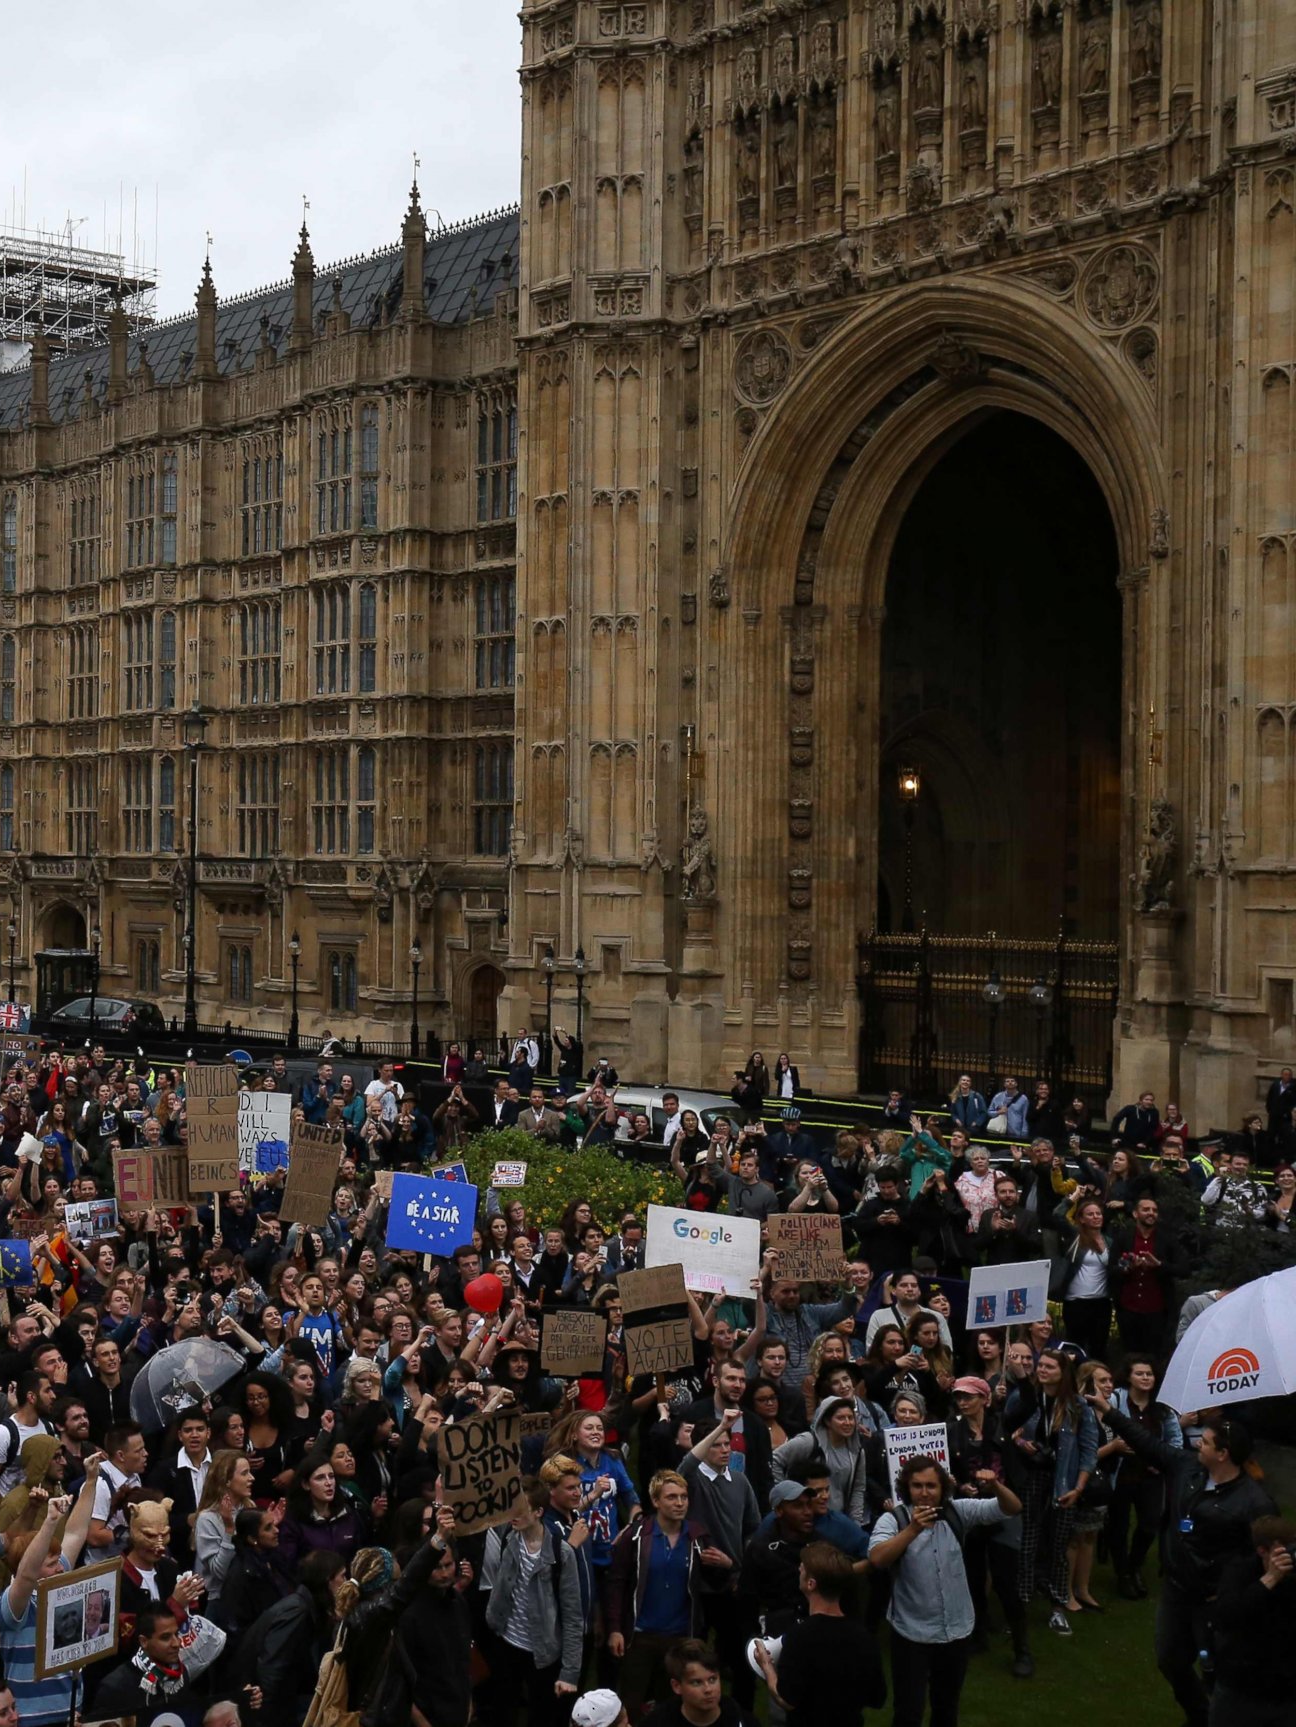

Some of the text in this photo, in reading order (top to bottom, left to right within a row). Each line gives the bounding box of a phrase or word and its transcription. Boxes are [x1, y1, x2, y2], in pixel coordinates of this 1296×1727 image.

[188, 1067, 238, 1097] REFUGEES
[208, 1098, 220, 1114] R
[189, 1123, 236, 1144] HUMAN
[240, 1131, 278, 1144] WAYS
[298, 1122, 342, 1145] UNITED
[259, 1148, 281, 1166] EU
[190, 1162, 238, 1181] BEINGS
[407, 1201, 460, 1224] BE A STAR
[673, 1218, 733, 1245] Google
[780, 1216, 840, 1229] POLITICIANS
[777, 1229, 821, 1241] ARE LIKE
[789, 1239, 830, 1251] SPERM
[778, 1250, 823, 1261] ONE IN A
[551, 1323, 596, 1334] VOICE OF
[626, 1322, 689, 1351] VOTE
[1207, 1373, 1260, 1395] TODAY
[889, 1428, 945, 1441] THIS IS LONDON
[889, 1440, 945, 1455] LONDON VOTED
[444, 1442, 520, 1490] LISTEN
[475, 1477, 494, 1495] TO
